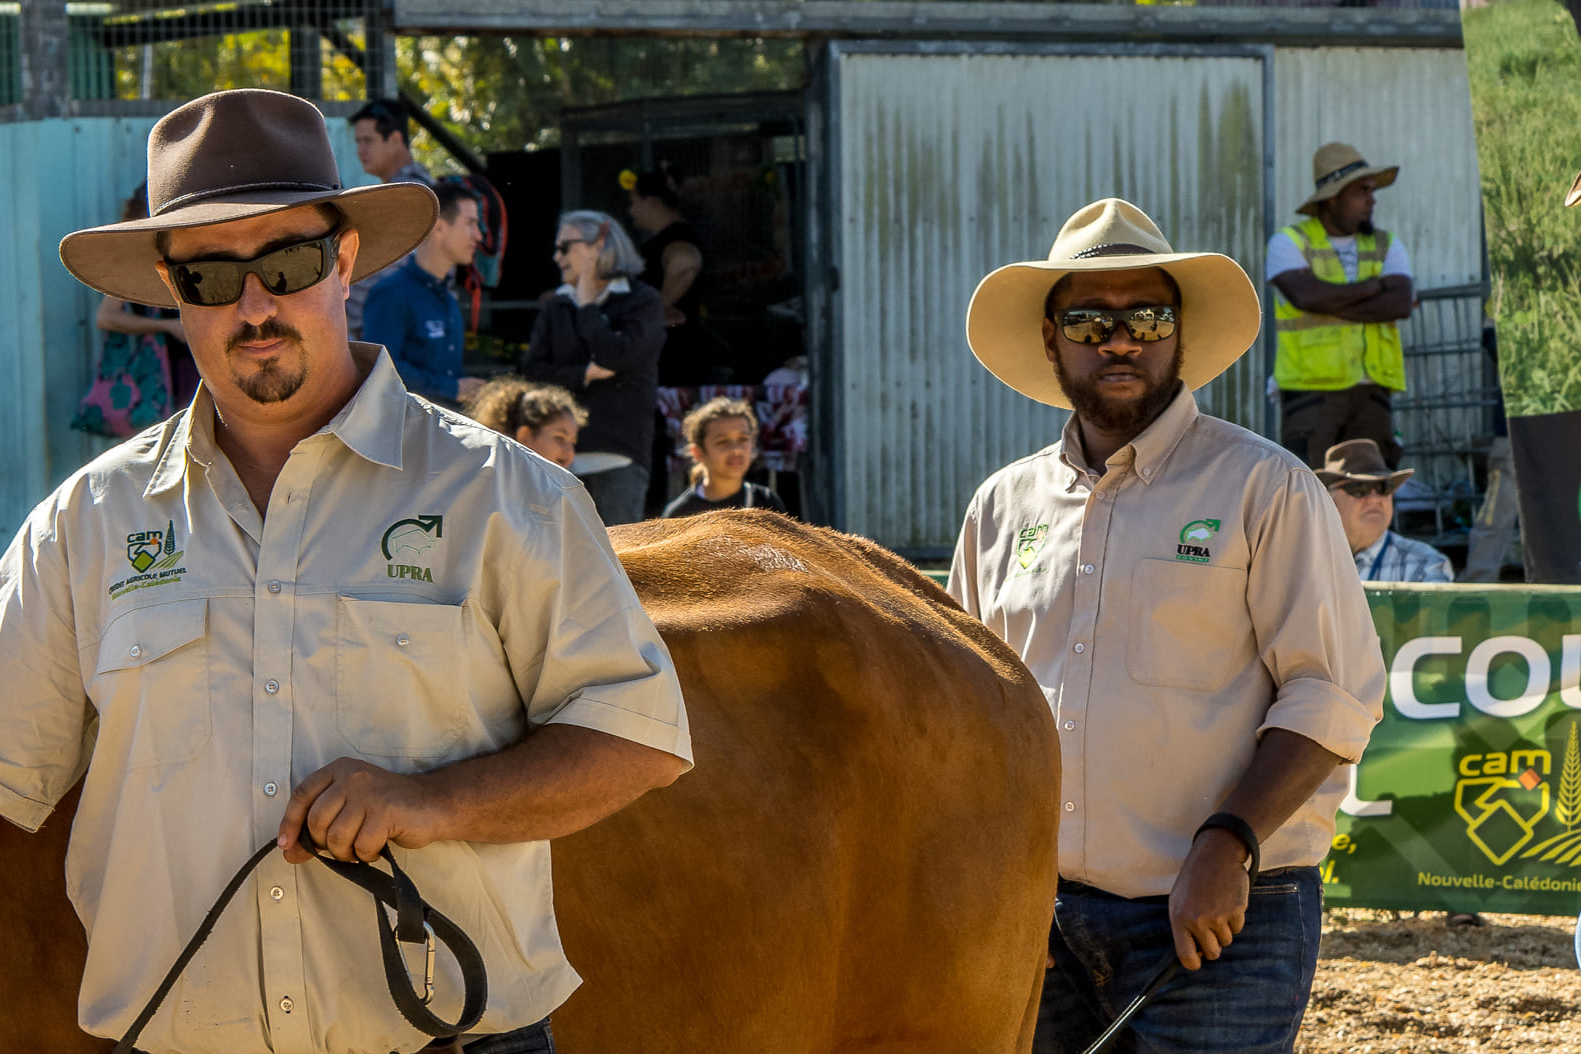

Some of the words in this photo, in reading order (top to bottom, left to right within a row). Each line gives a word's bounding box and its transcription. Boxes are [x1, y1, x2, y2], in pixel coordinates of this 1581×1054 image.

[127, 530, 163, 543] cam
[1177, 544, 1211, 557] UPRA
[387, 564, 434, 583] UPRA
[1459, 749, 1551, 776] cam
